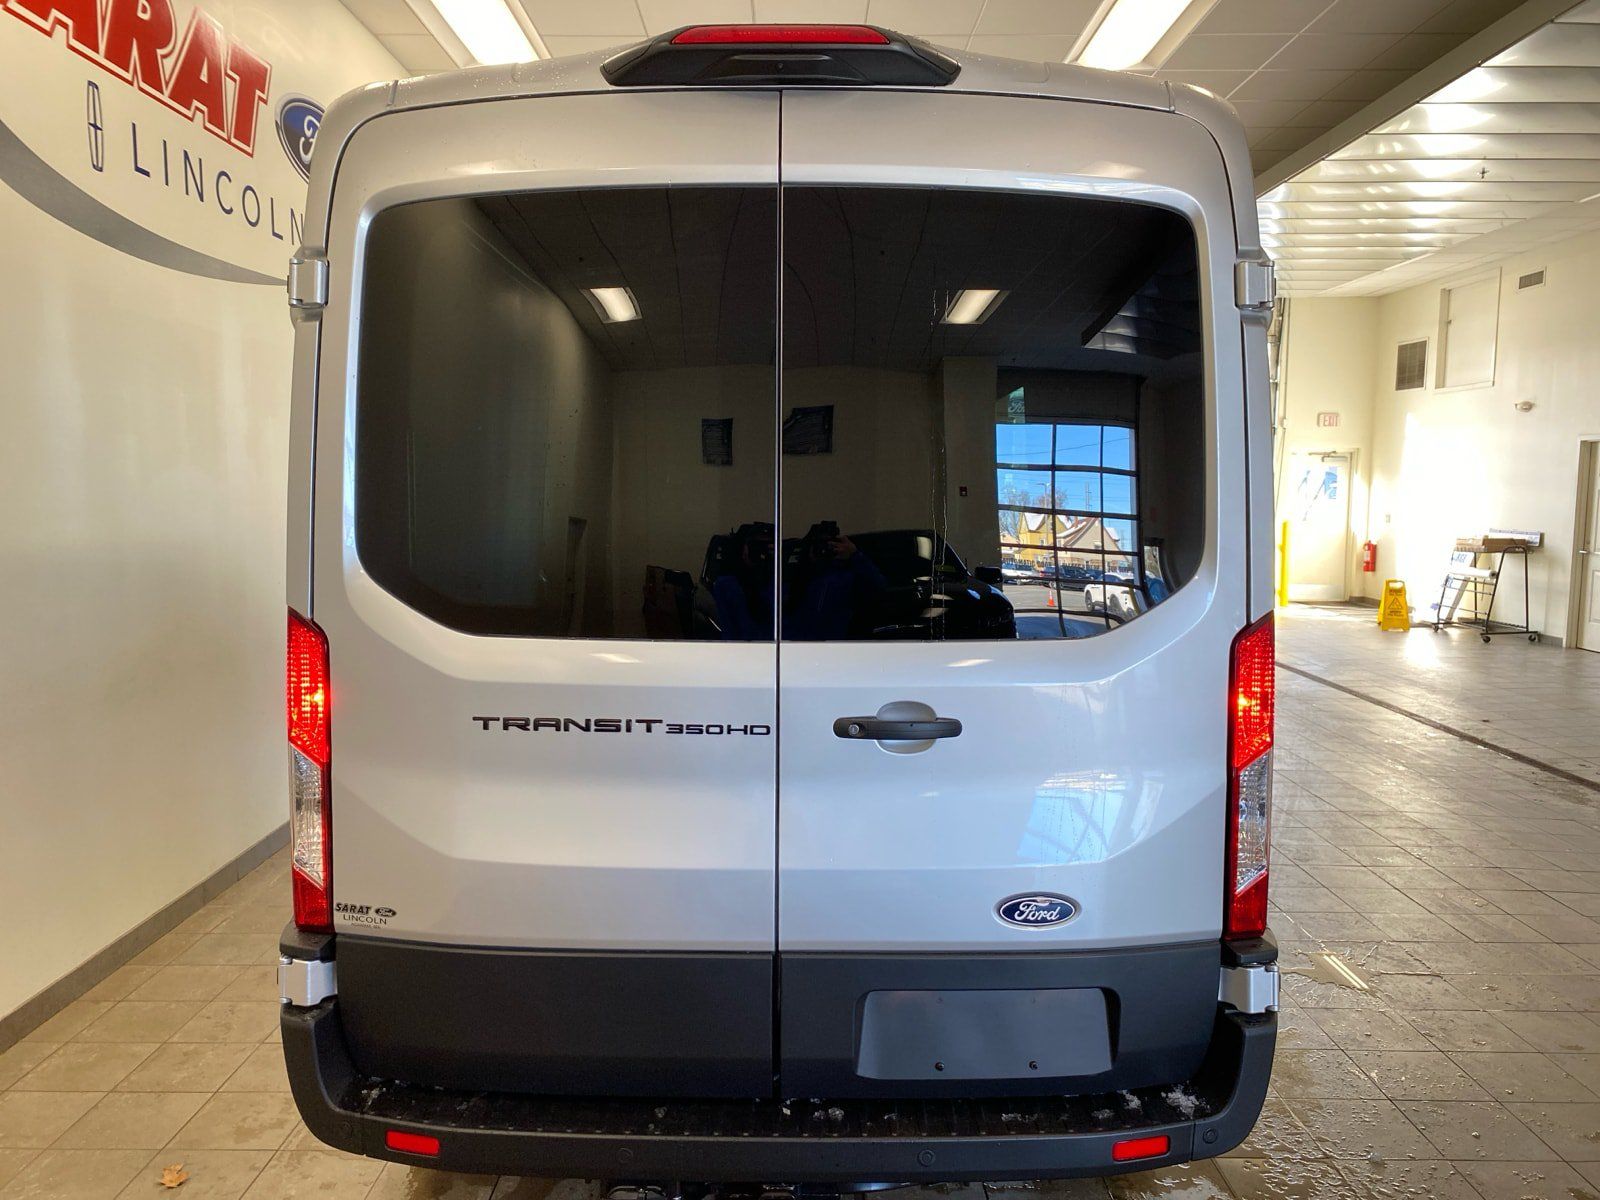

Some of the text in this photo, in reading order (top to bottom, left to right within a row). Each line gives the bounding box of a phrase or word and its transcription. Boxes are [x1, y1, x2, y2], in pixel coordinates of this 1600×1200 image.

[131, 121, 304, 246] LINCOLN
[472, 716, 772, 736] TRANSIT 350HD
[335, 902, 372, 915] SARAT
[1014, 901, 1061, 921] Ford
[343, 914, 387, 925] LINCOLN
